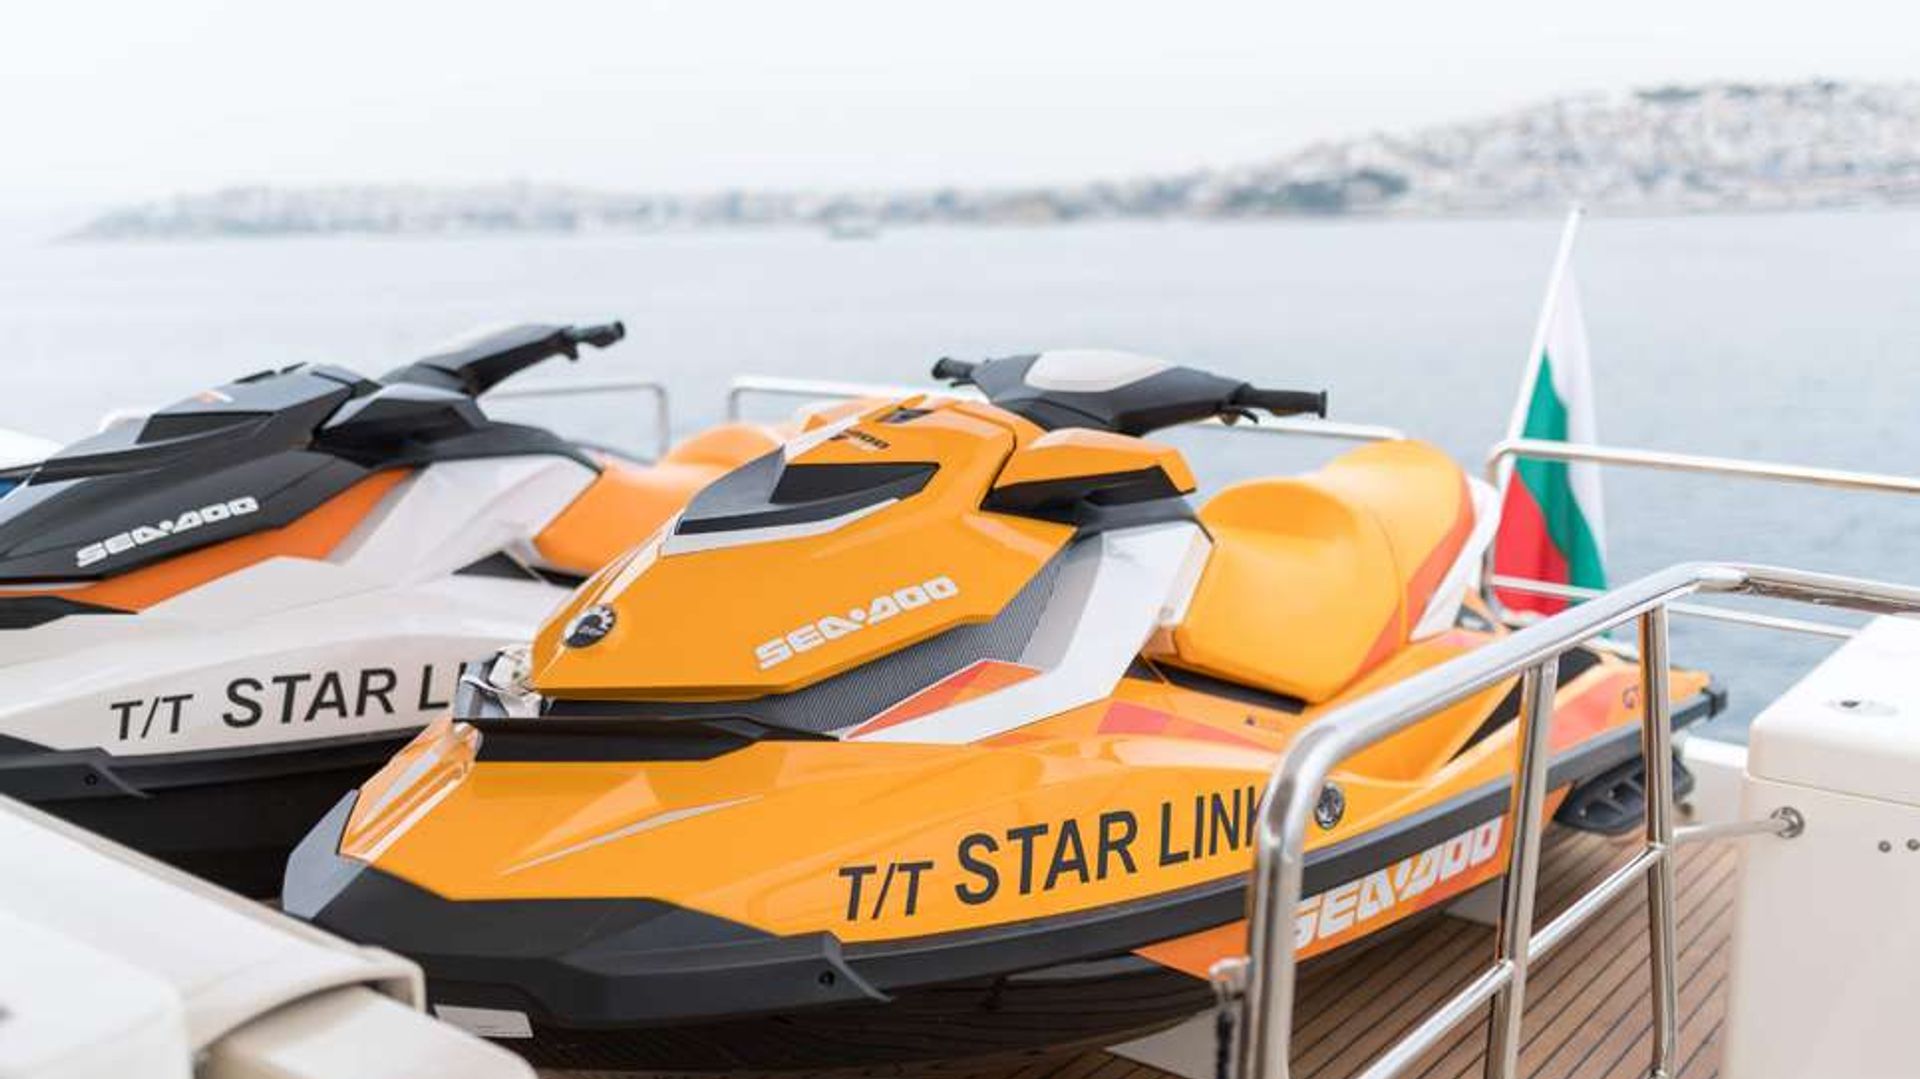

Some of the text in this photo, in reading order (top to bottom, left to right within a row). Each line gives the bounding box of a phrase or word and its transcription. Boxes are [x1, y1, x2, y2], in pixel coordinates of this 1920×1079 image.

[110, 694, 193, 740] T/T
[222, 668, 397, 728] STAR
[838, 861, 934, 921] T/T
[954, 810, 1138, 905] STAR
